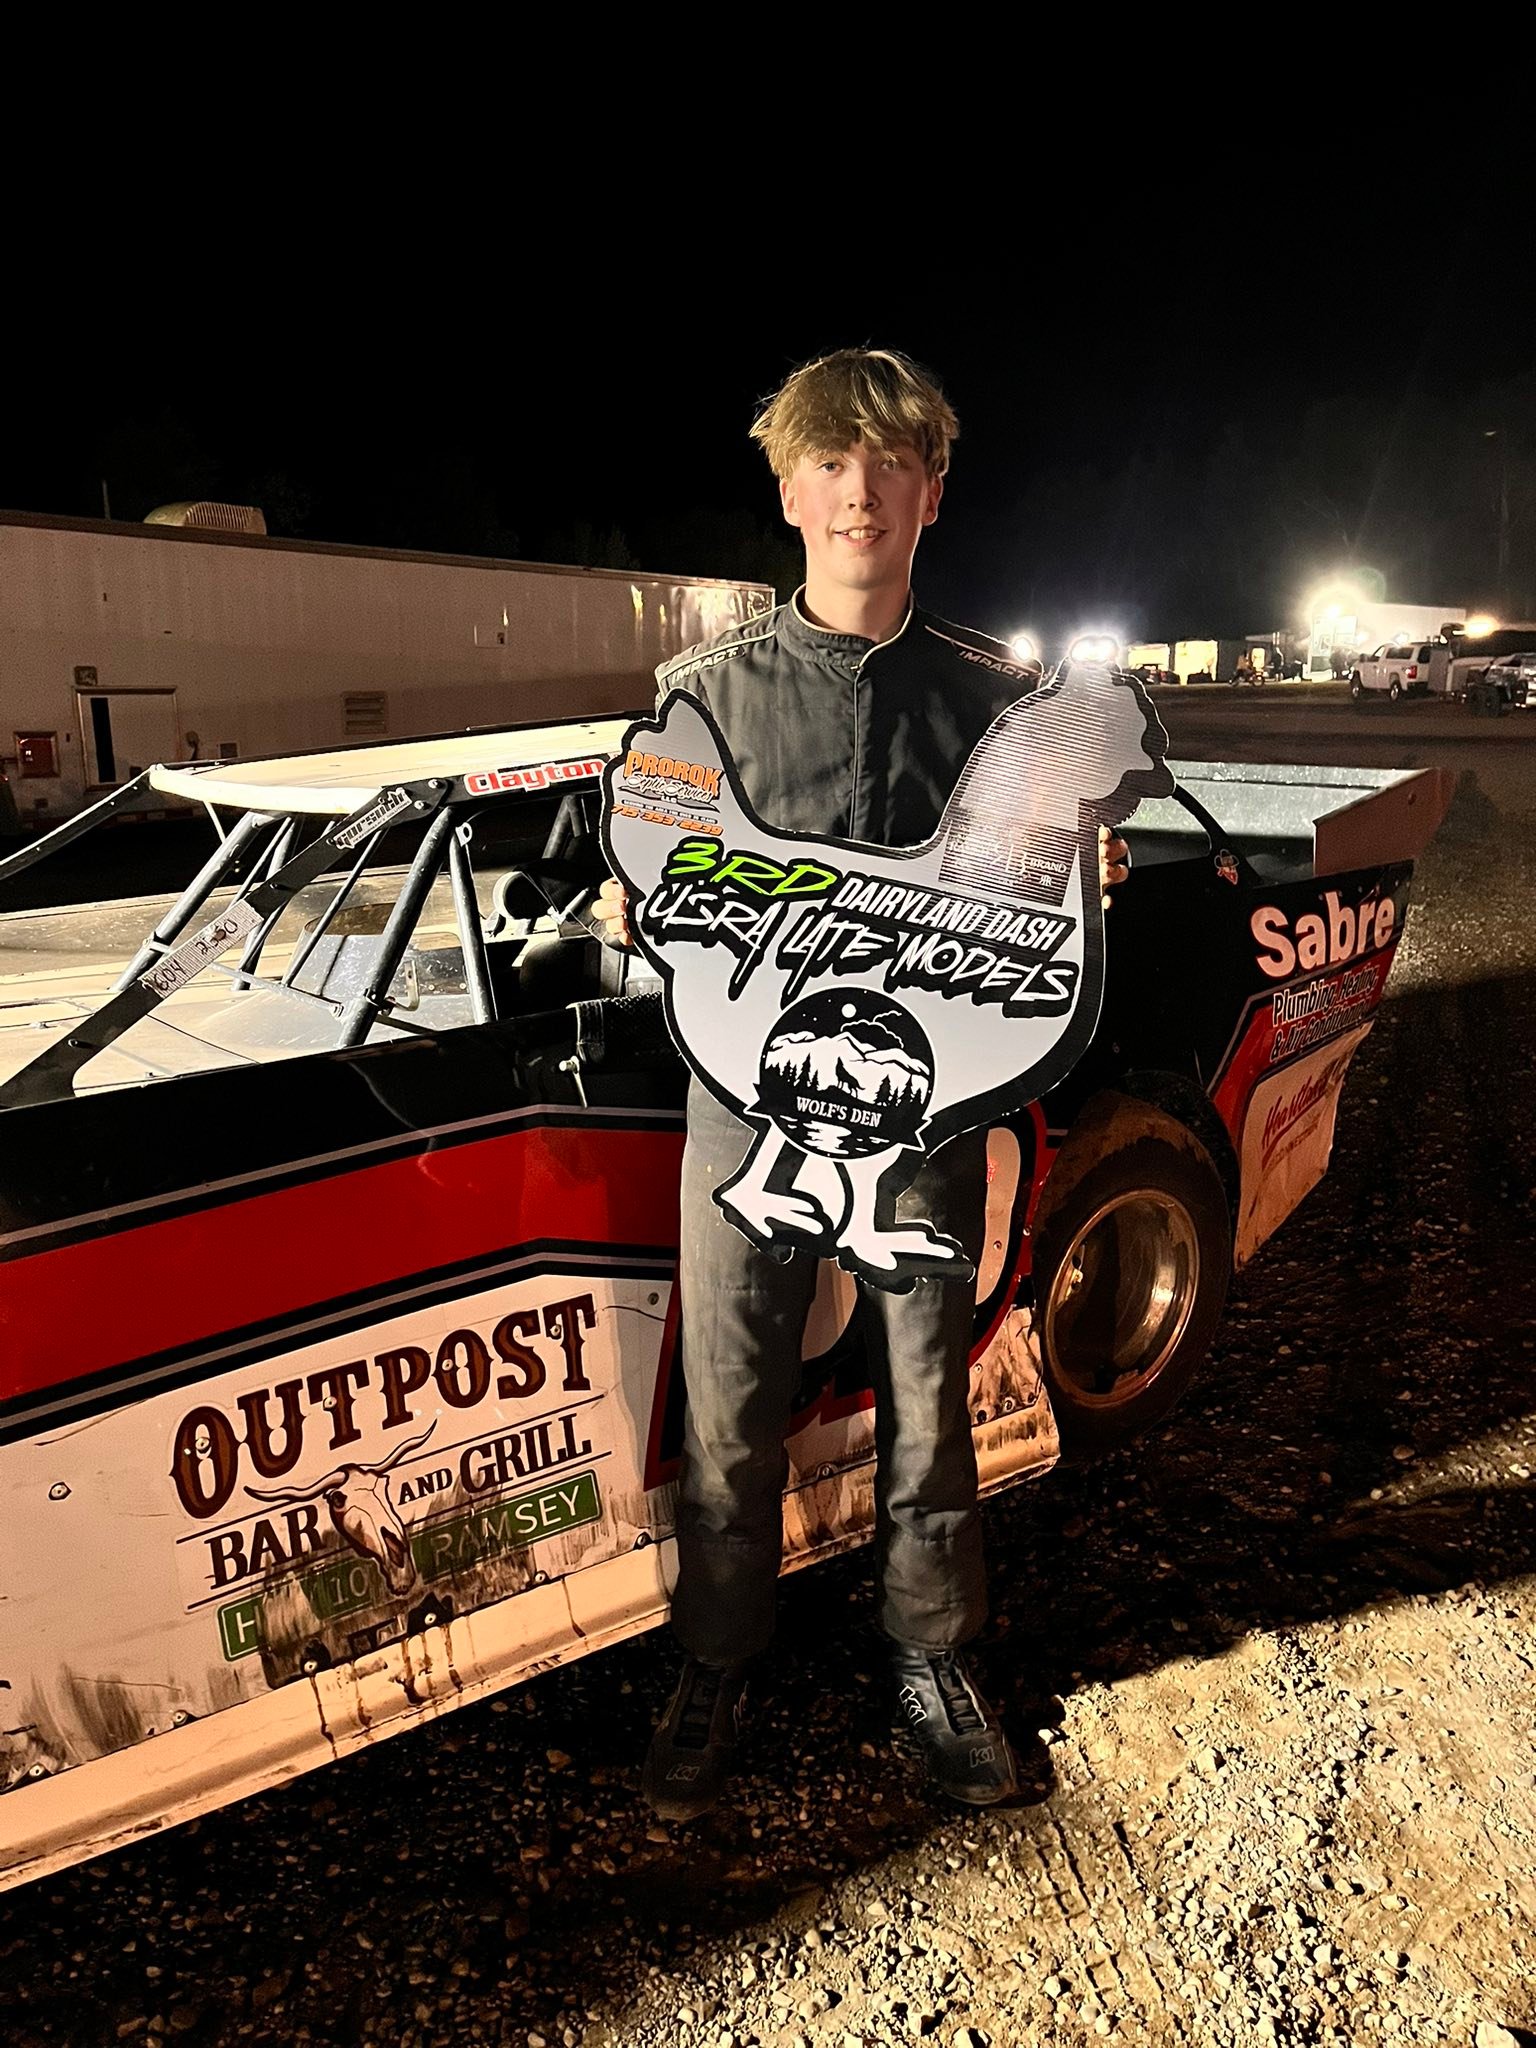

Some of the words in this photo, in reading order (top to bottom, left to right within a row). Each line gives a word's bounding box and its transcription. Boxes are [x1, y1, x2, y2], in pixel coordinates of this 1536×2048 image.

[671, 646, 738, 685] IMPACT
[959, 650, 1029, 680] IMPACT
[466, 760, 604, 794] Clayton
[623, 749, 723, 799] PROROK
[661, 795, 678, 804] LLC
[667, 842, 838, 896] 3RD
[1029, 857, 1068, 875] BRAND
[831, 878, 983, 934] DAIRYLAND
[980, 909, 1068, 951] DASH
[1250, 890, 1395, 978] Sabre
[648, 883, 786, 985] USRA
[782, 911, 895, 996] LATE
[890, 931, 1075, 1002] MODELS
[153, 959, 188, 992] 604
[1269, 1028, 1286, 1063] &
[796, 1096, 847, 1121] WOLF'S
[849, 1108, 883, 1128] DEN
[168, 1293, 596, 1519] OUTPOST
[206, 1504, 326, 1589] BAR
[397, 1468, 453, 1506] AND
[459, 1412, 592, 1496] GRILL
[431, 1485, 580, 1567] RAMSEY
